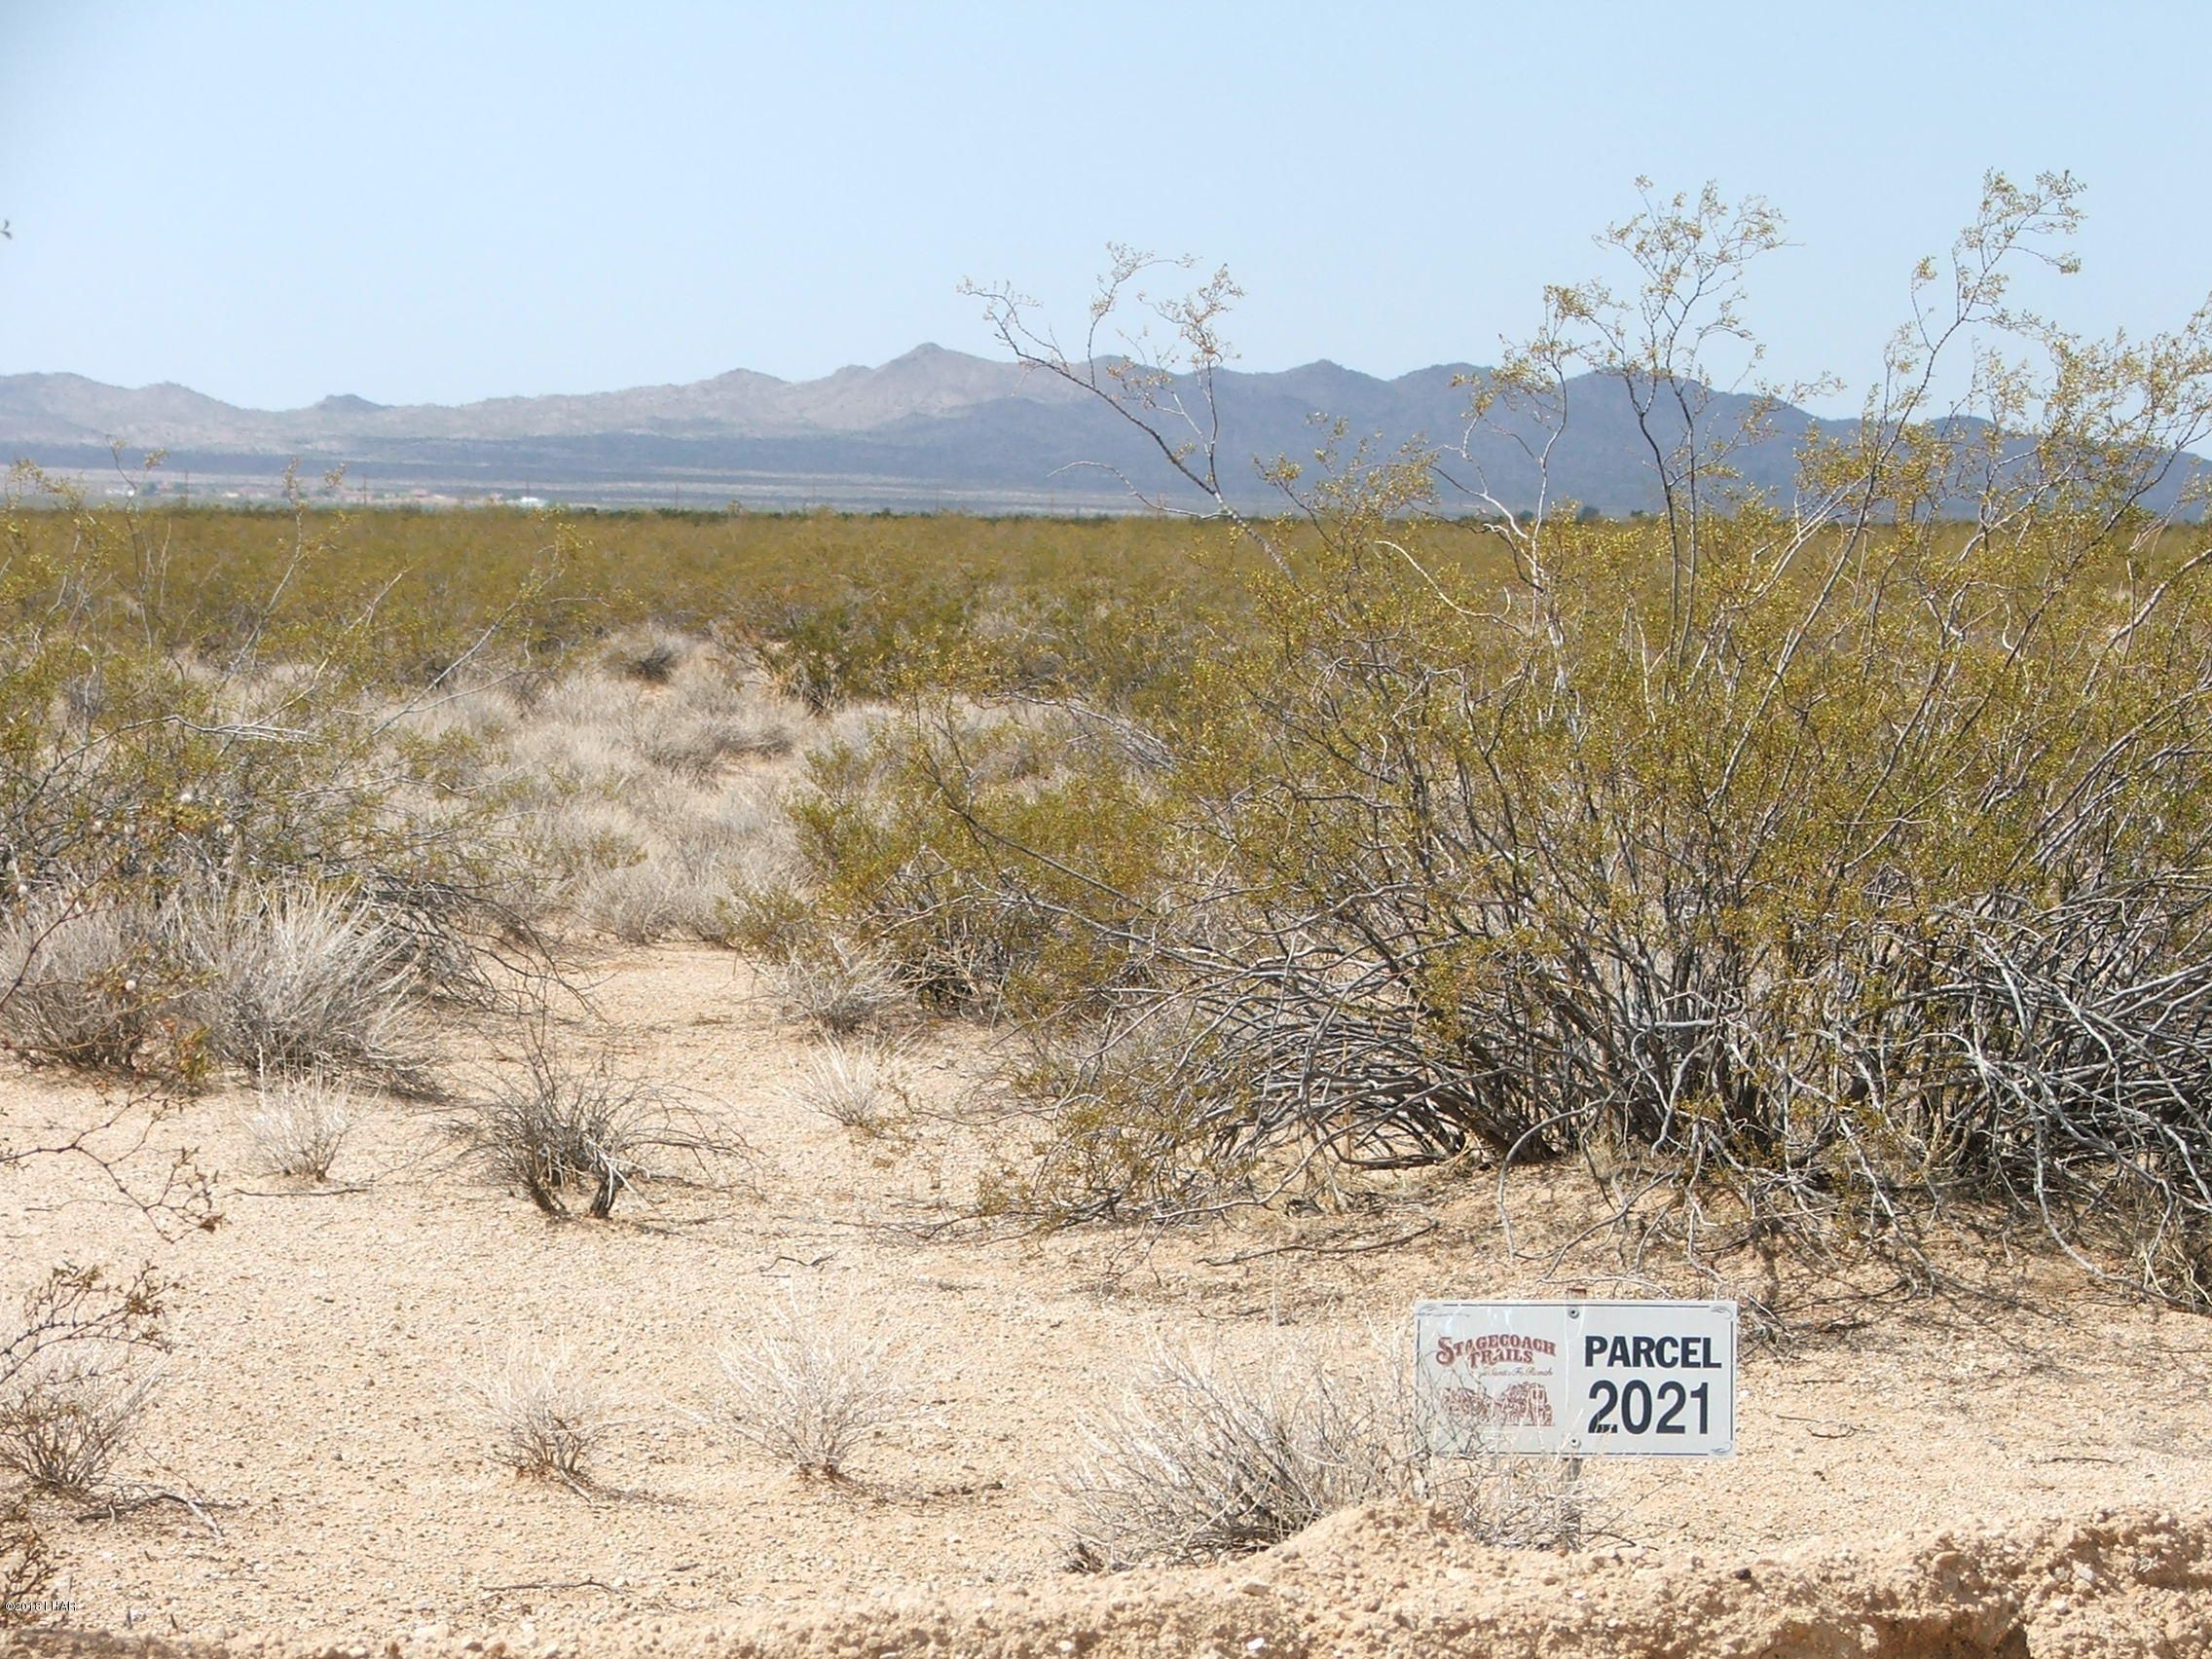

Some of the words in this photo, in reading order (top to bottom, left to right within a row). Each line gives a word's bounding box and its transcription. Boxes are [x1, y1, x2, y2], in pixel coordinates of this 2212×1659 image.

[1436, 1334, 1557, 1365] STAGECOACH
[1467, 1348, 1533, 1369] TRAILS
[1585, 1335, 1722, 1368] PARCEL
[1588, 1380, 1709, 1435] 2021
